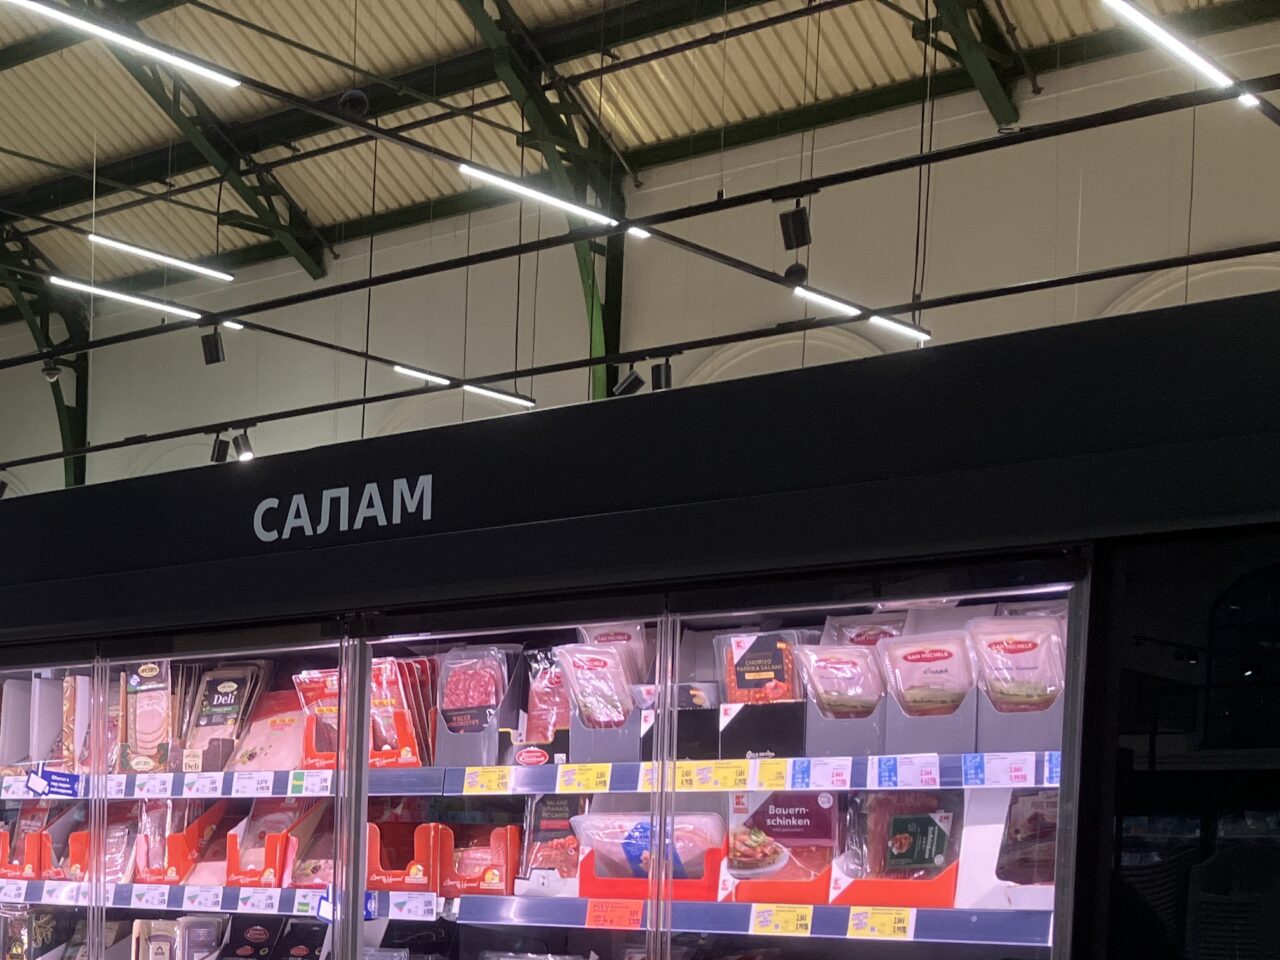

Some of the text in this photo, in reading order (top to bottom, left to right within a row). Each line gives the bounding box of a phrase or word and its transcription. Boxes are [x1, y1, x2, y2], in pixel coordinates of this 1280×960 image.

[253, 473, 433, 542] САЛАМ
[213, 692, 235, 705] Deli
[768, 804, 810, 815] Bauern-
[766, 817, 811, 827] schinken
